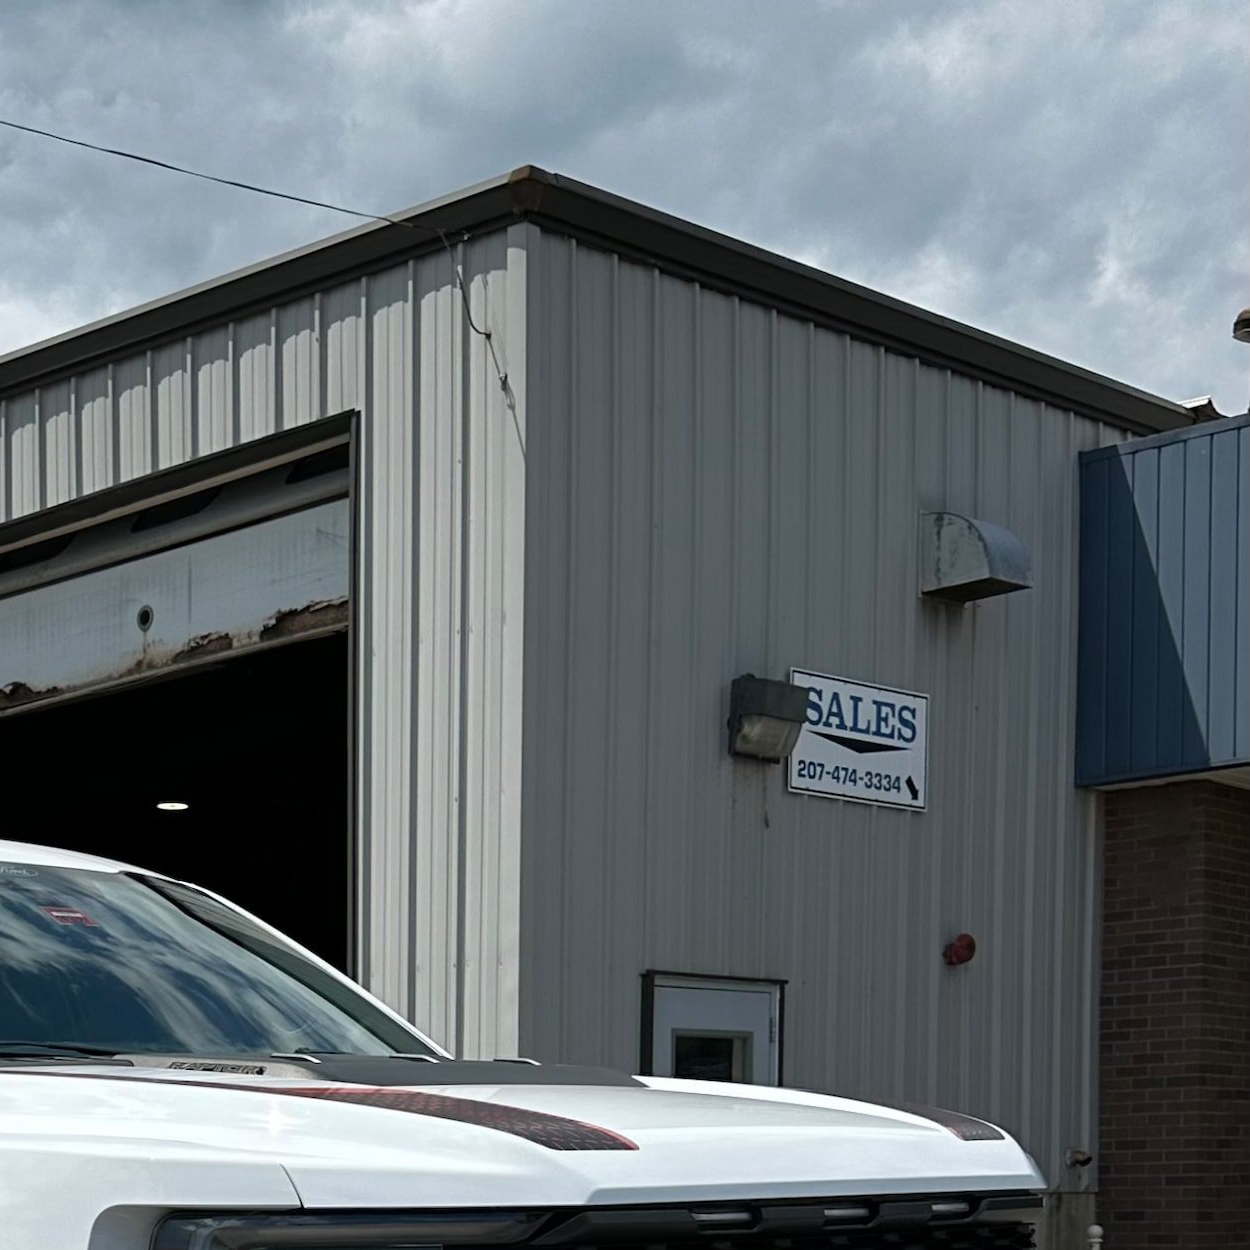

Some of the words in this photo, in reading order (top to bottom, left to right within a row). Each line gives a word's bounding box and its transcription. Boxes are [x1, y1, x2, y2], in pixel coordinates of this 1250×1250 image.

[806, 687, 918, 744] SALES
[797, 759, 902, 793] 207-474-3334
[168, 1061, 267, 1076] RAPTOR
